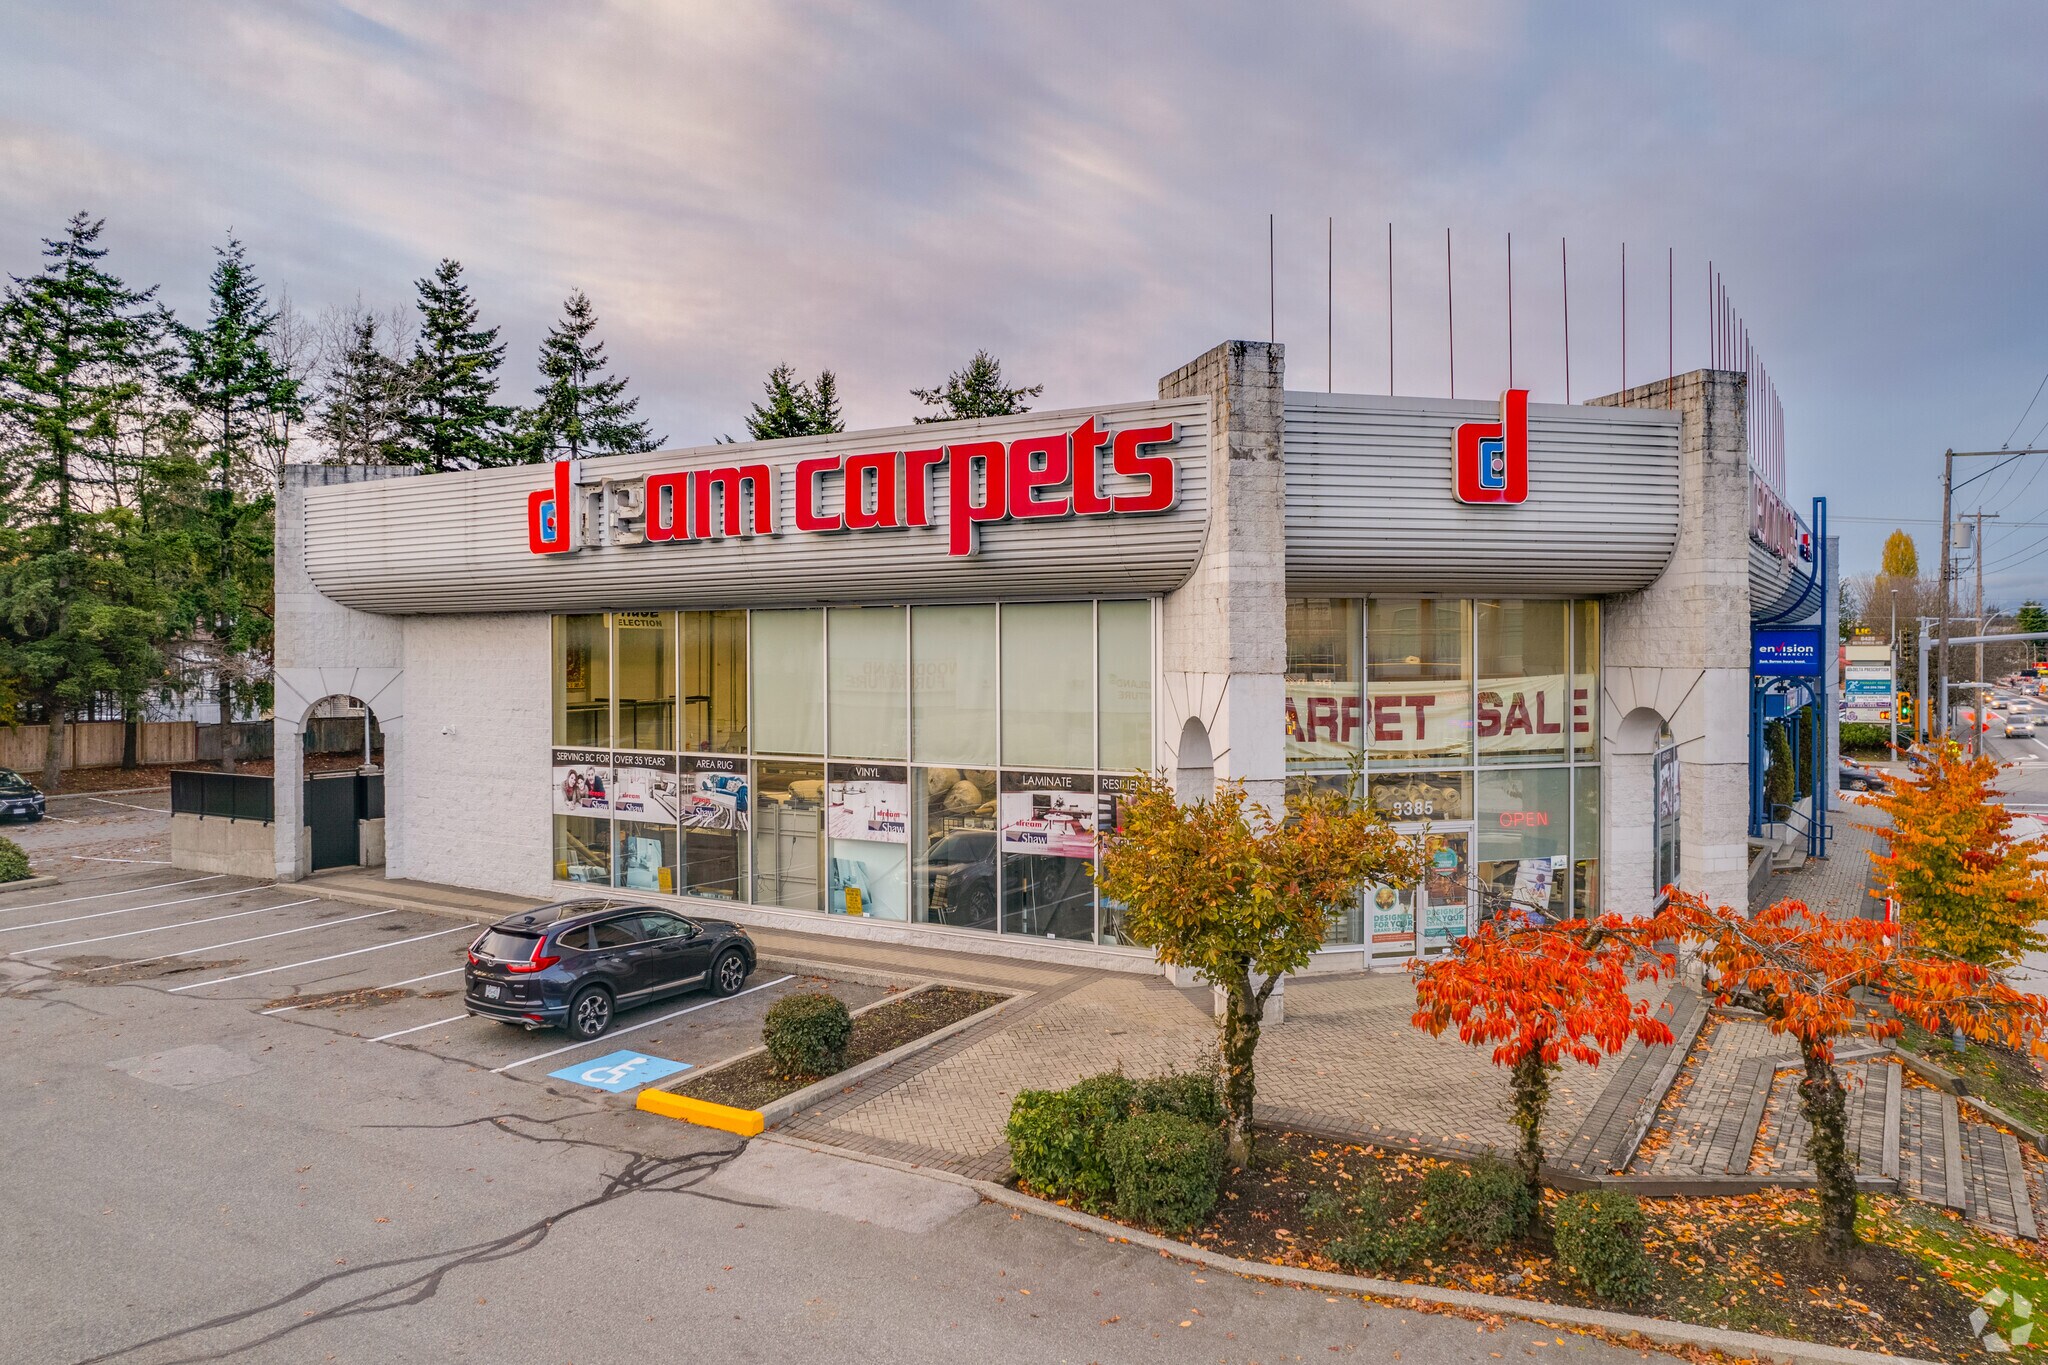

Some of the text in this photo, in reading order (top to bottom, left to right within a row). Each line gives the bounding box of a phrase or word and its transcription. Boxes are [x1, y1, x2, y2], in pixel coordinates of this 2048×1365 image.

[528, 414, 1181, 557] dream carpets
[618, 618, 663, 627] ELECTION
[1759, 642, 1814, 653] envision
[1285, 689, 1590, 743] ARPET SALE
[556, 752, 666, 767] SERVING BC FOR OVER 35 YEARS
[695, 759, 733, 770] AREA RUG
[855, 767, 880, 778] VINYL
[1022, 775, 1072, 788] LAMINATE
[591, 799, 609, 810] Shaw
[626, 803, 644, 813] Shaw
[877, 809, 901, 818] dream
[1015, 819, 1042, 828] dream
[1499, 811, 1548, 828] OPEN
[882, 822, 904, 833] Shaw
[1021, 832, 1047, 844] Shaw
[1374, 913, 1413, 921] DESIGND
